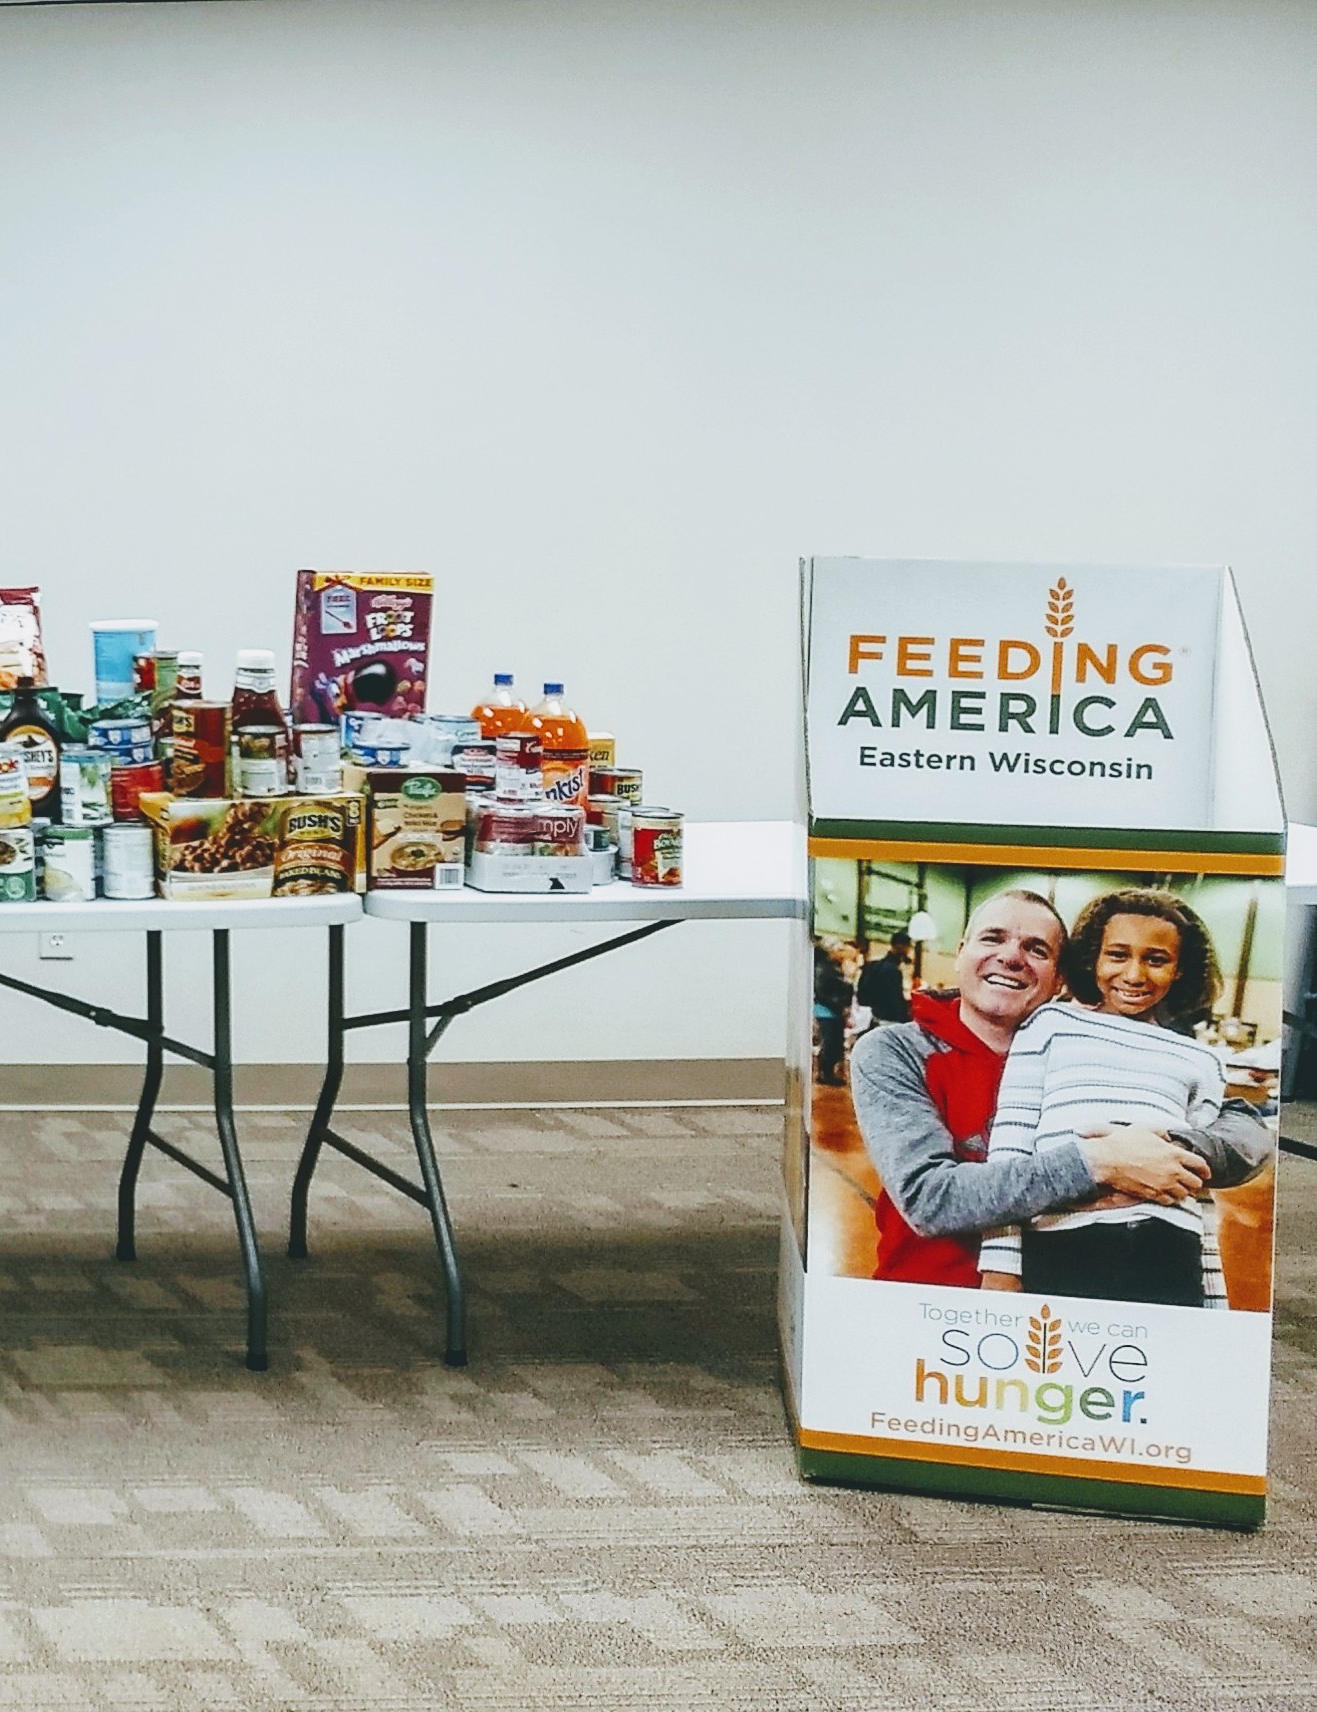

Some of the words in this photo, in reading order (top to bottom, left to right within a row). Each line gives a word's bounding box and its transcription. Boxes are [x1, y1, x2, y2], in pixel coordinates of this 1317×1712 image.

[360, 577, 402, 586] FAMILY
[405, 578, 431, 587] SIZE
[370, 624, 415, 641] LOOPS
[331, 640, 425, 668] Marshmallows
[848, 633, 1174, 690] FEEDING
[837, 685, 1175, 740] AMERICA
[859, 746, 976, 772] Eastern
[989, 751, 1154, 781] Wisconsin
[289, 814, 342, 833] BUSH'S
[349, 801, 360, 817] 8
[919, 1302, 1025, 1330] Together
[1068, 1320, 1102, 1336] we
[1107, 1323, 1148, 1339] can
[915, 1358, 1147, 1426] hunger.
[870, 1411, 1192, 1465] FeedingAmericaWI.org
